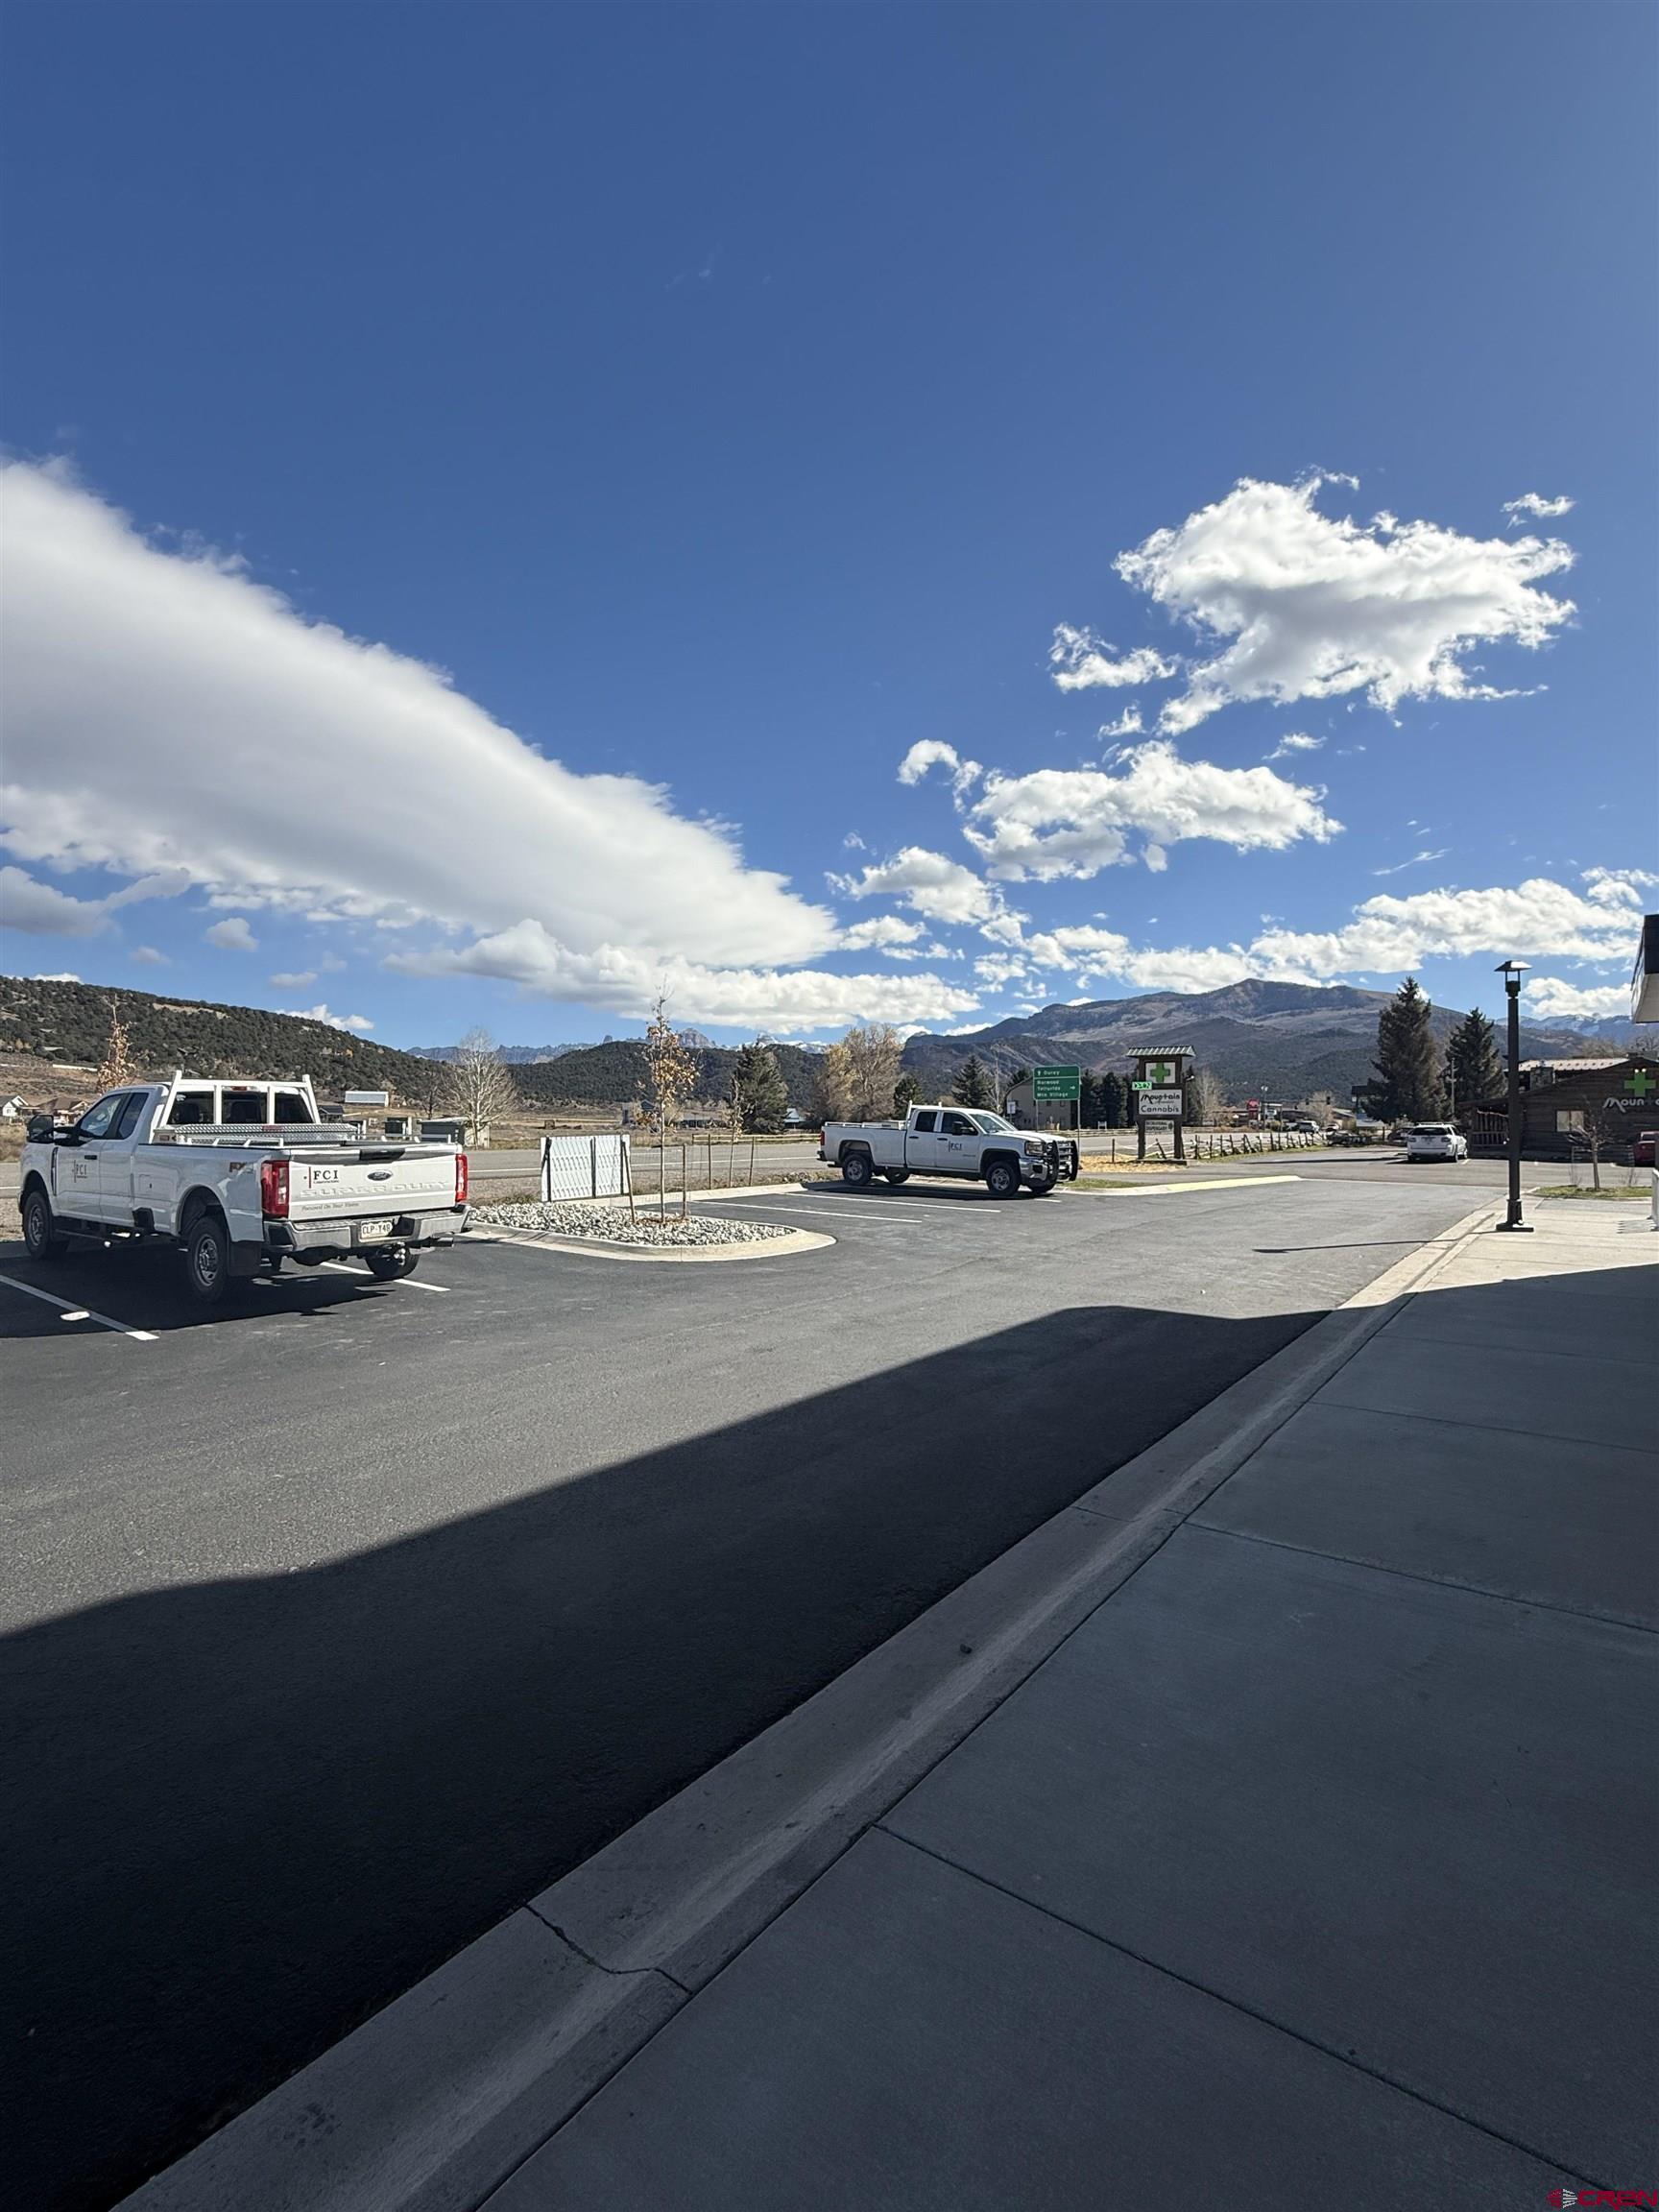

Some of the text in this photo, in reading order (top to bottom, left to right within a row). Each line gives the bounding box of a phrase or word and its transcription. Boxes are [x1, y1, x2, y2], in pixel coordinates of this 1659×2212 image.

[1141, 1094, 1180, 1104] Mountain
[313, 1169, 338, 1180] FCI
[301, 1181, 446, 1197] SUPER DUTY
